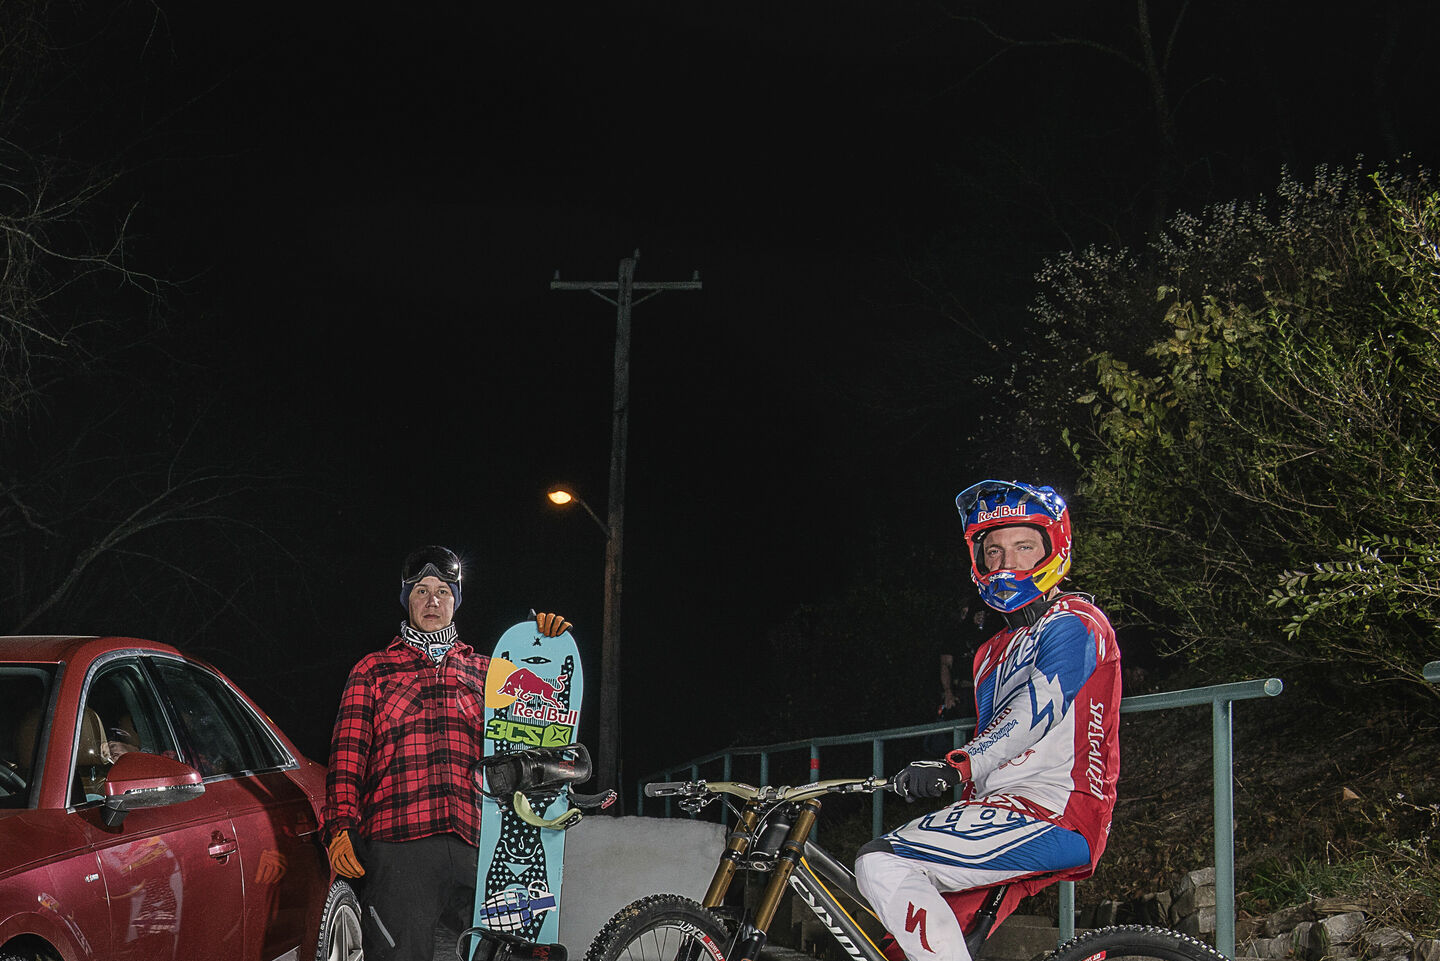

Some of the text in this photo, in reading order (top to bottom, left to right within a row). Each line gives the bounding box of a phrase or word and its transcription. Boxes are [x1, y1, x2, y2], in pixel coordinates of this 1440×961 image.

[978, 504, 1026, 523] Red Bull
[513, 702, 578, 725] Red Bull
[486, 719, 544, 746] 3CS
[1085, 697, 1105, 800] SPECIALIZED
